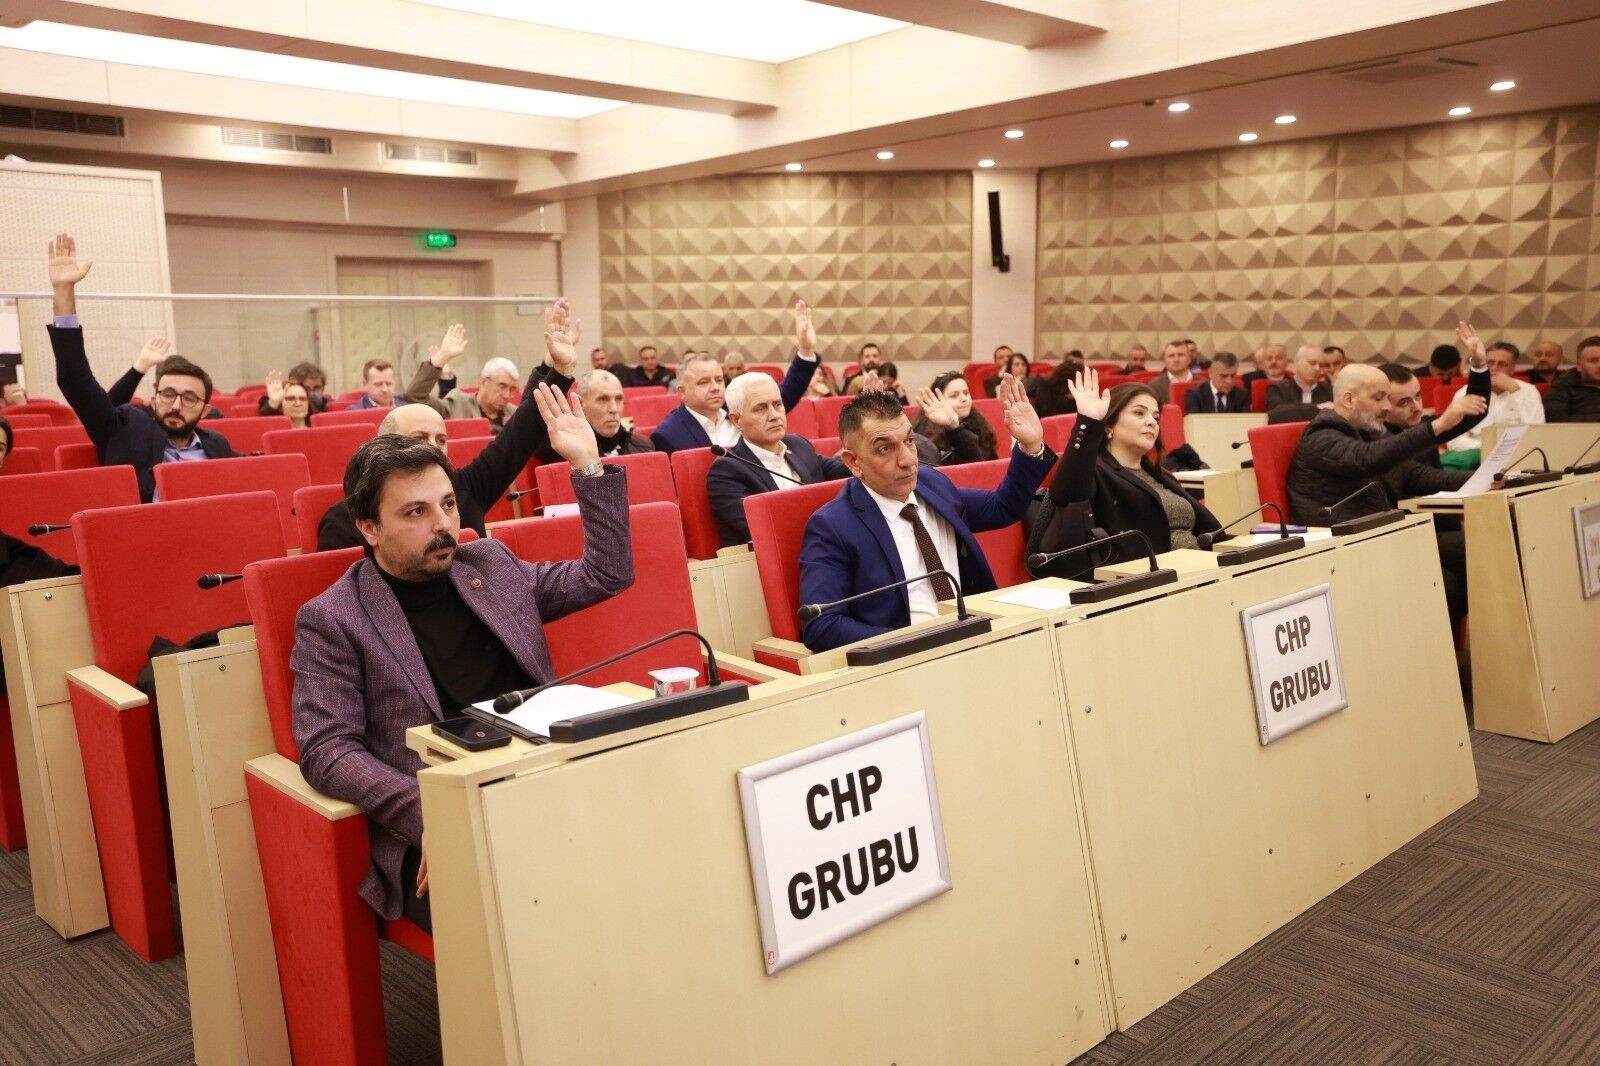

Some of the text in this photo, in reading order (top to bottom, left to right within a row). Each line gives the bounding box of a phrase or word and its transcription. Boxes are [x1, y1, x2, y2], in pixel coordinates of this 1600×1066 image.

[1275, 615, 1311, 655] CHP
[1269, 660, 1332, 713] GRUBU
[806, 765, 882, 831] CHP
[787, 826, 919, 920] GRUBU
